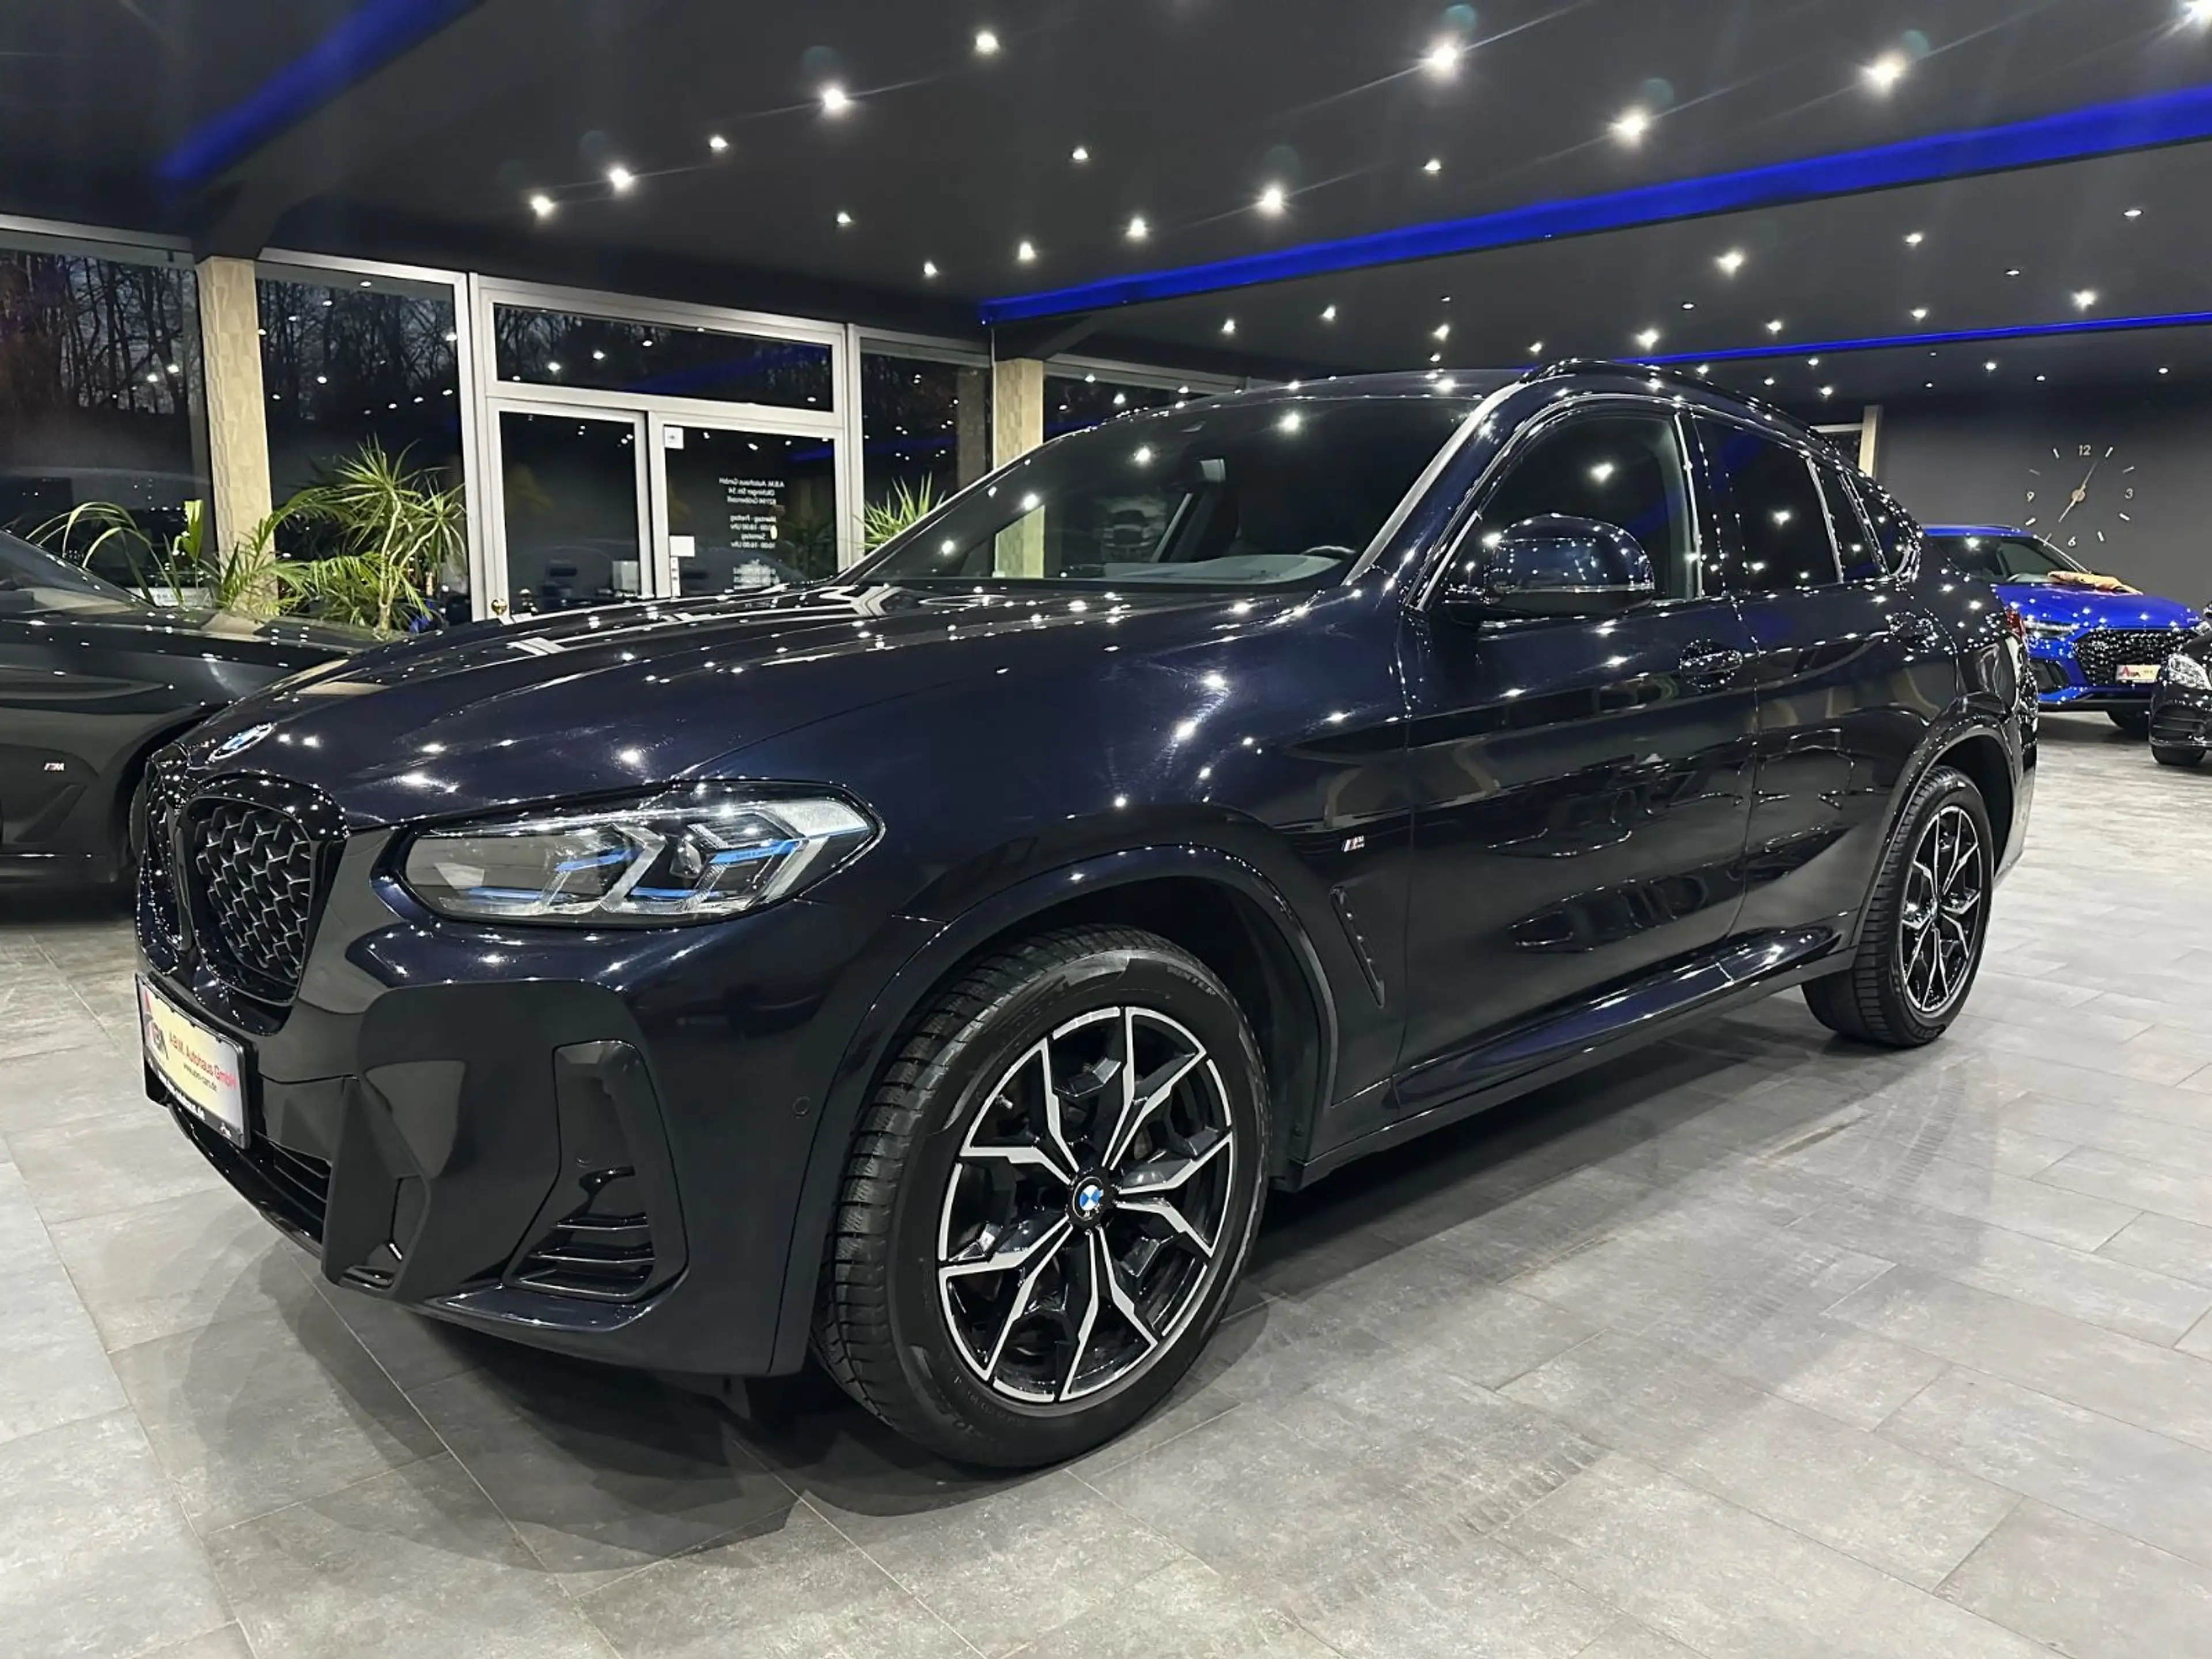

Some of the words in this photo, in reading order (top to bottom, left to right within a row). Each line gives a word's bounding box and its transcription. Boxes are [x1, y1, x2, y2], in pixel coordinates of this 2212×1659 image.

[2078, 444, 2091, 456] 12
[2027, 491, 2035, 502] 9
[2124, 488, 2134, 499] 3
[2068, 536, 2076, 547] 6
[186, 1045, 214, 1077] Autohaus
[214, 1064, 237, 1090] GmbH
